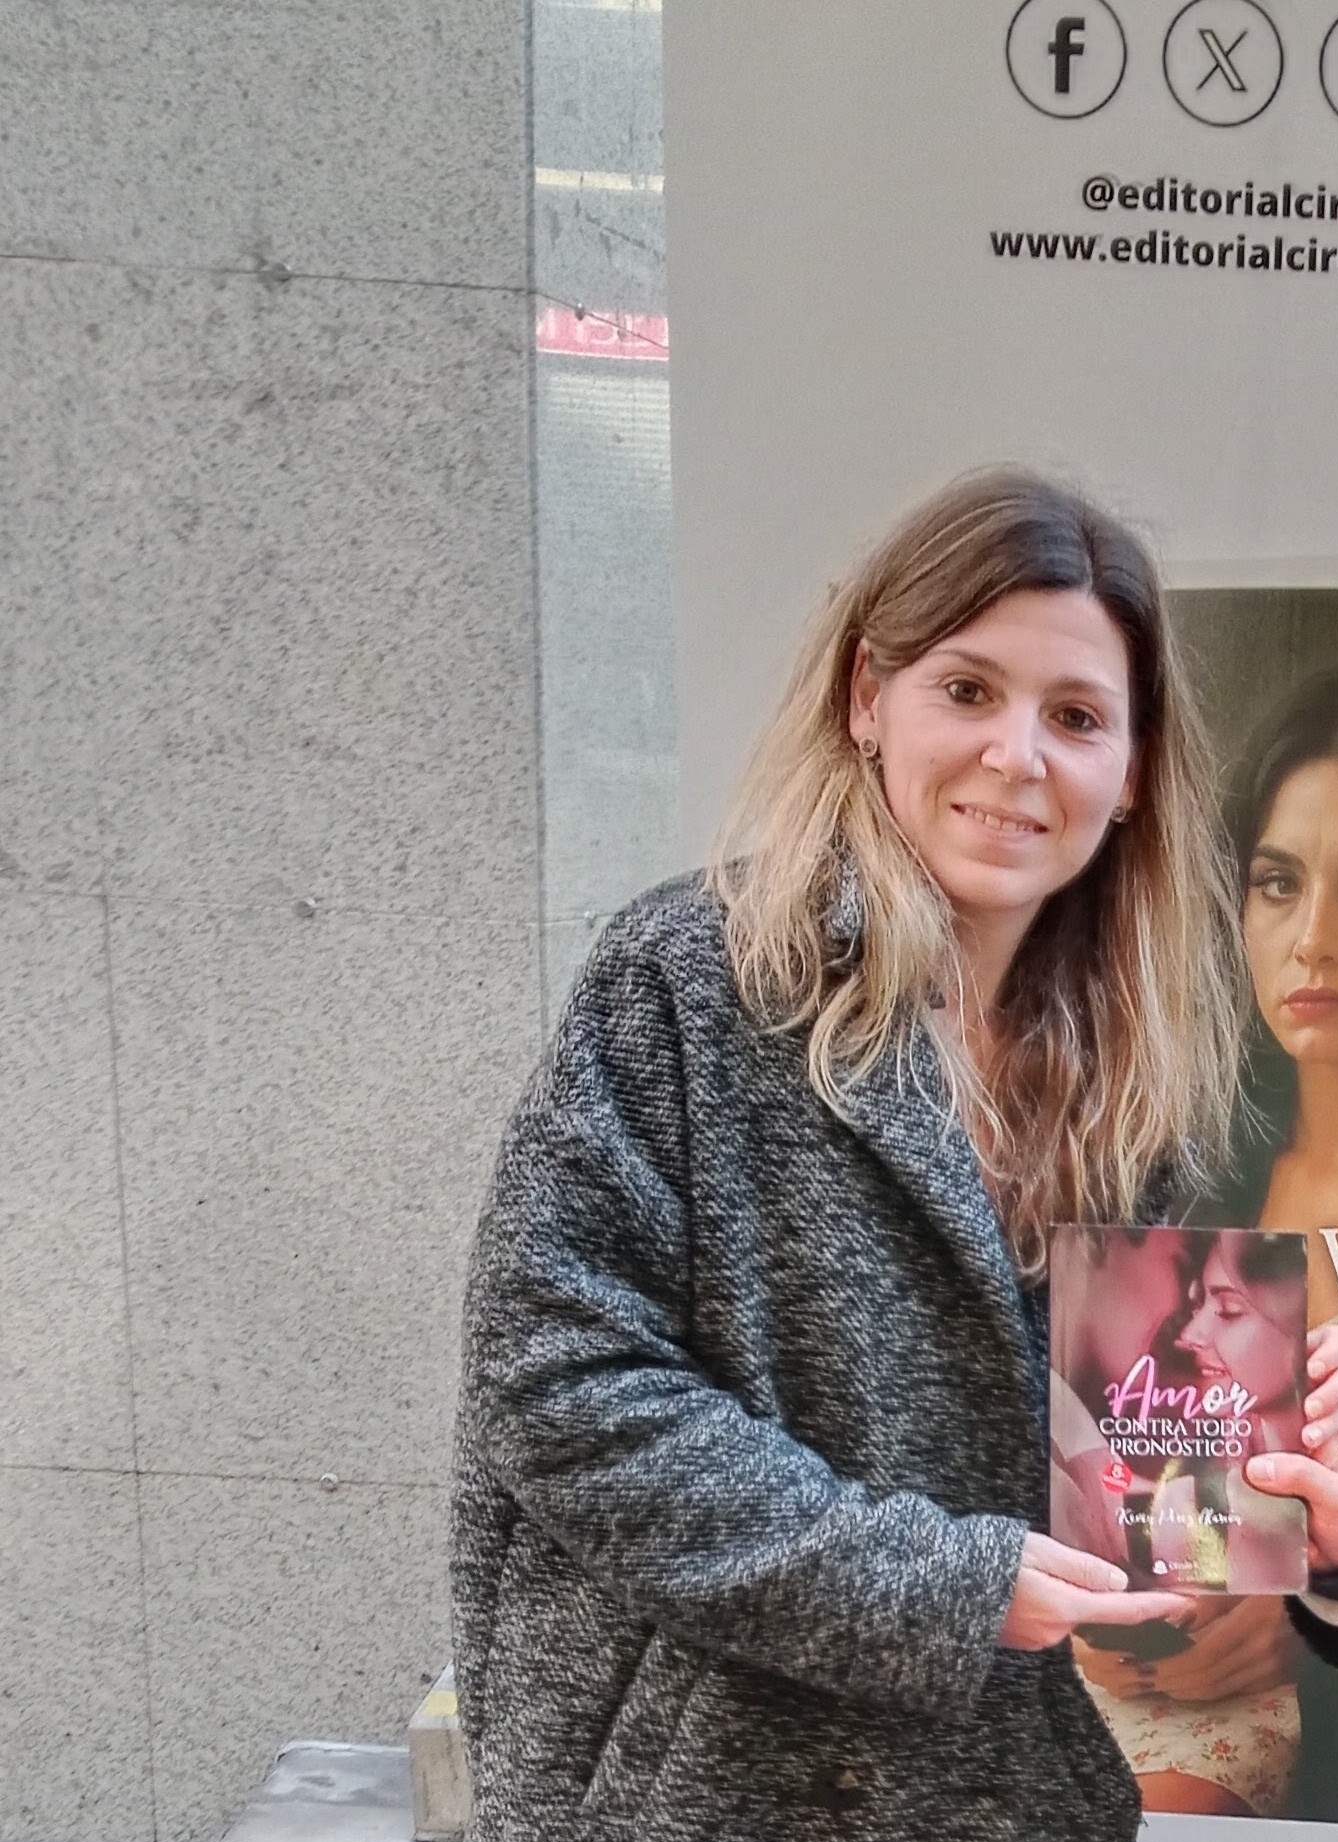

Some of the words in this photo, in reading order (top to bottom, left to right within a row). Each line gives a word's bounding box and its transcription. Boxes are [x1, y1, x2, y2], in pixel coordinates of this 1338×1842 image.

[1103, 1354, 1258, 1426] Amor
[1099, 1418, 1187, 1438] CONTRA
[1193, 1418, 1252, 1438] TODO
[1110, 1434, 1243, 1457] PRONÓSTICO
